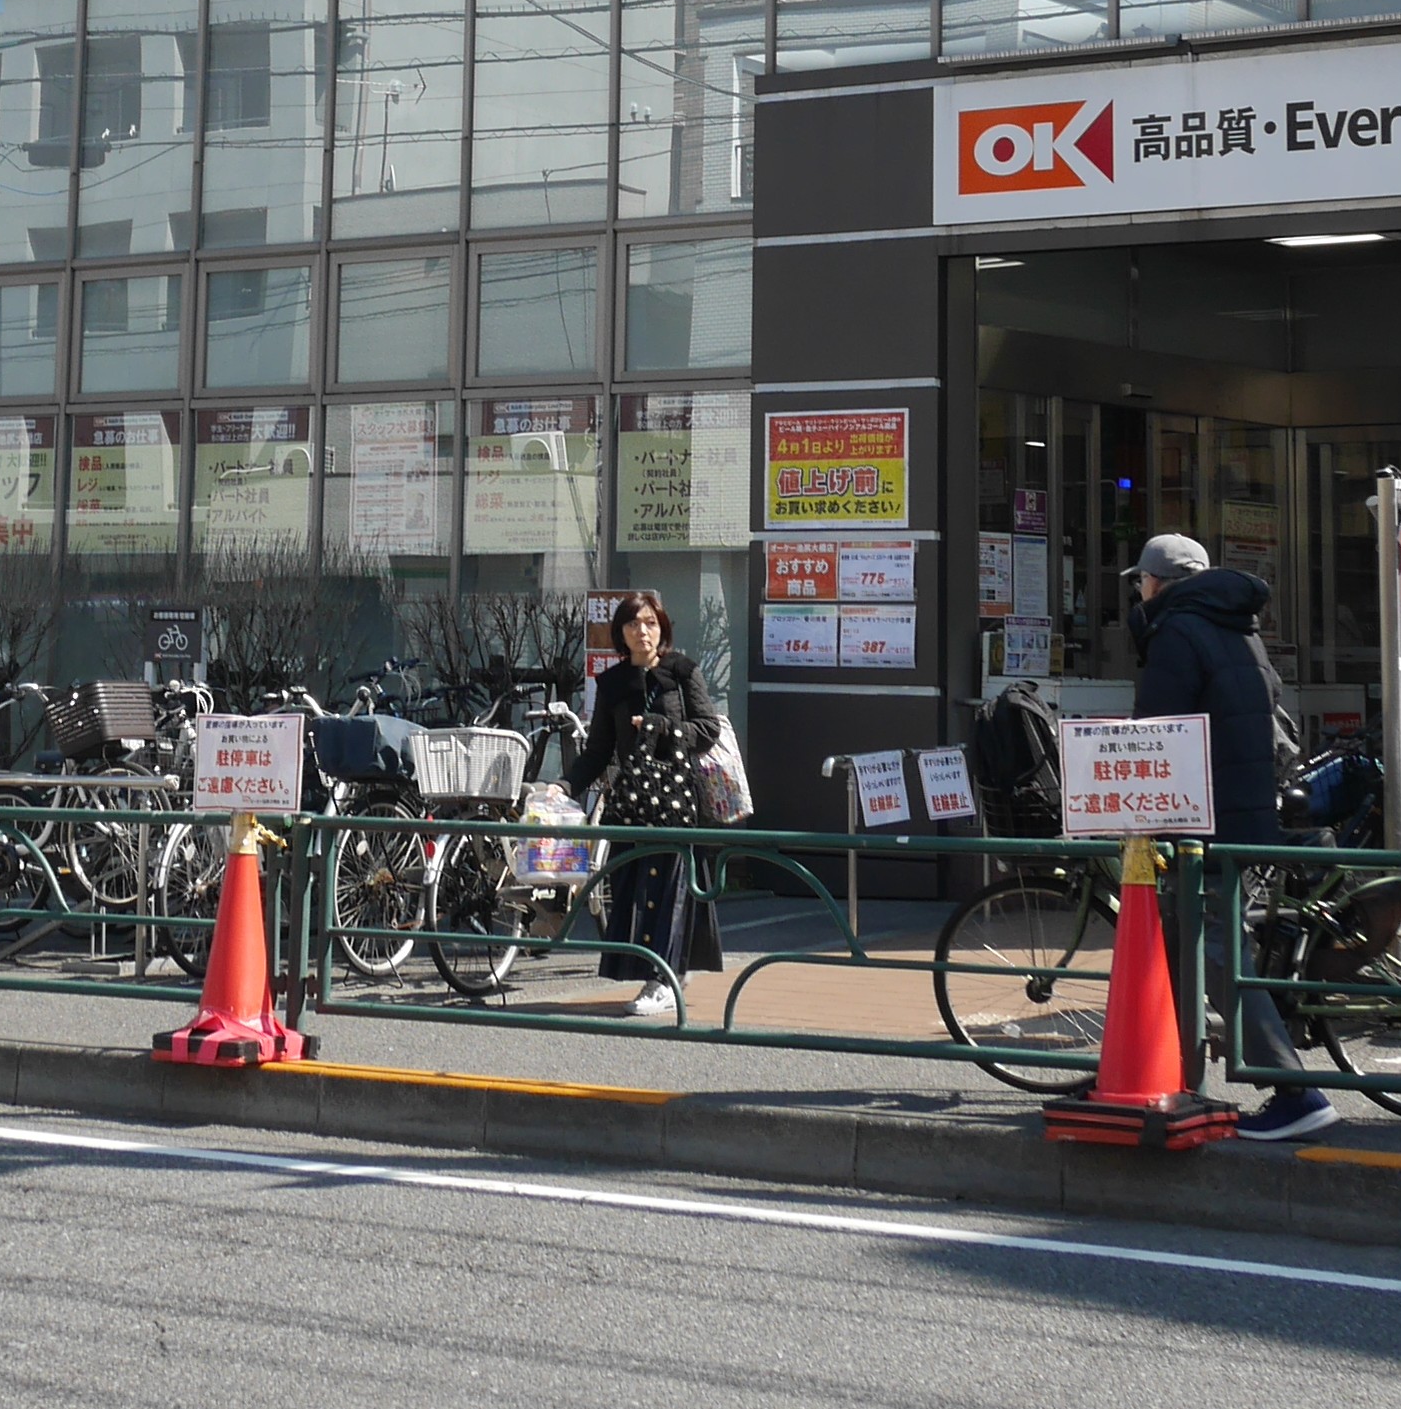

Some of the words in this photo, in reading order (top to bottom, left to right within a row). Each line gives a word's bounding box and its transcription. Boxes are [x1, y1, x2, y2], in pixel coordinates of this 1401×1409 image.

[972, 100, 1109, 186] OK
[494, 416, 572, 433] 急募のお仕事
[93, 429, 159, 445] 急募のお仕事
[477, 445, 504, 462] 検品
[777, 437, 845, 455] 4月1日より
[78, 456, 102, 471] 検品
[77, 478, 98, 492] レジ
[476, 470, 501, 485] レジ
[776, 558, 829, 575] おすすめ
[861, 572, 886, 585] 775
[787, 579, 817, 596] 商品
[1098, 741, 1165, 753] お買い物による
[216, 749, 272, 767] 駐停車は
[1094, 759, 1172, 781] 駐停車は
[198, 776, 290, 795] ご遠慮ください。
[931, 792, 970, 812] 駐輪禁止
[1068, 792, 1200, 814] ご遠慮ください。
